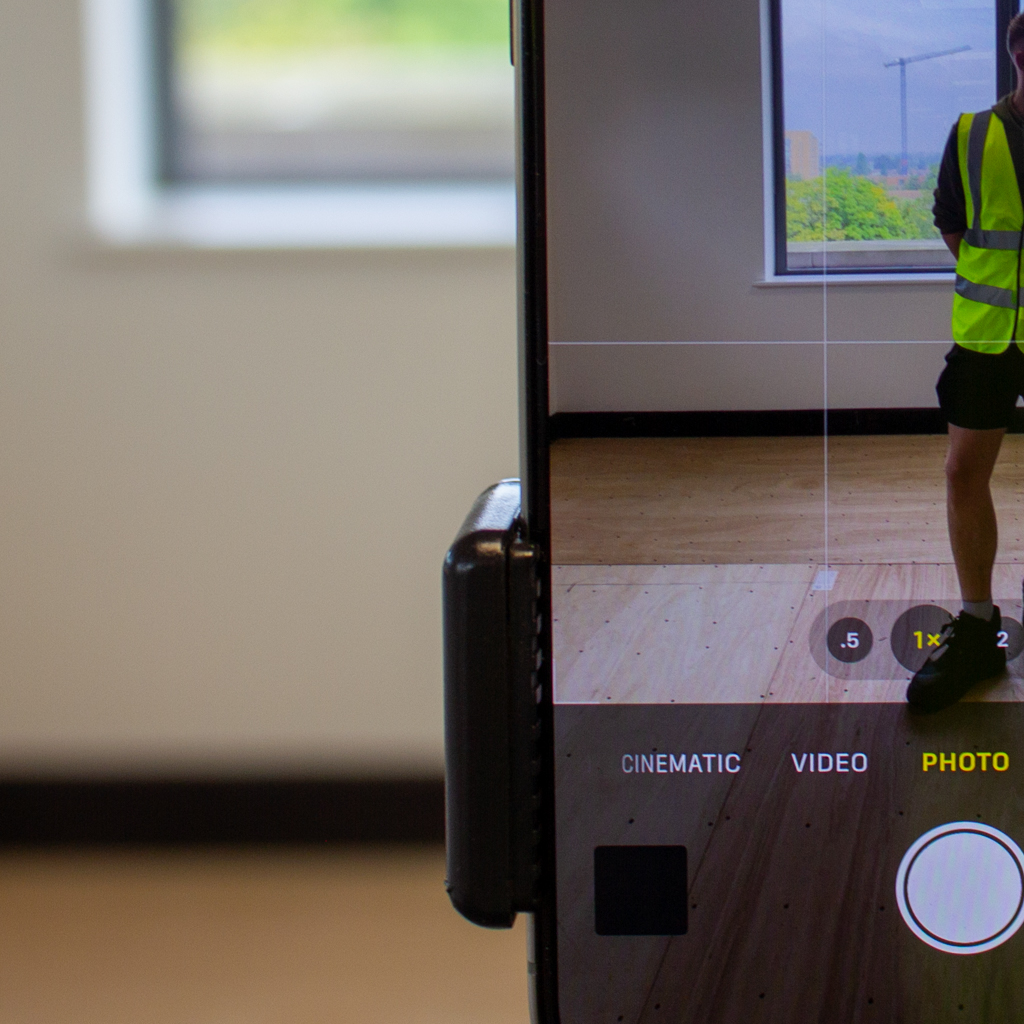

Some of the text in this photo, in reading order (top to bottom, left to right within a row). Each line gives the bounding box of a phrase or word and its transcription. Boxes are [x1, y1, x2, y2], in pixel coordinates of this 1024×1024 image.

[840, 632, 860, 649] .5
[996, 631, 1009, 648] 2
[621, 753, 742, 774] CINEMATIC
[791, 752, 869, 774] VIDEO
[922, 751, 1010, 773] PHOTO
